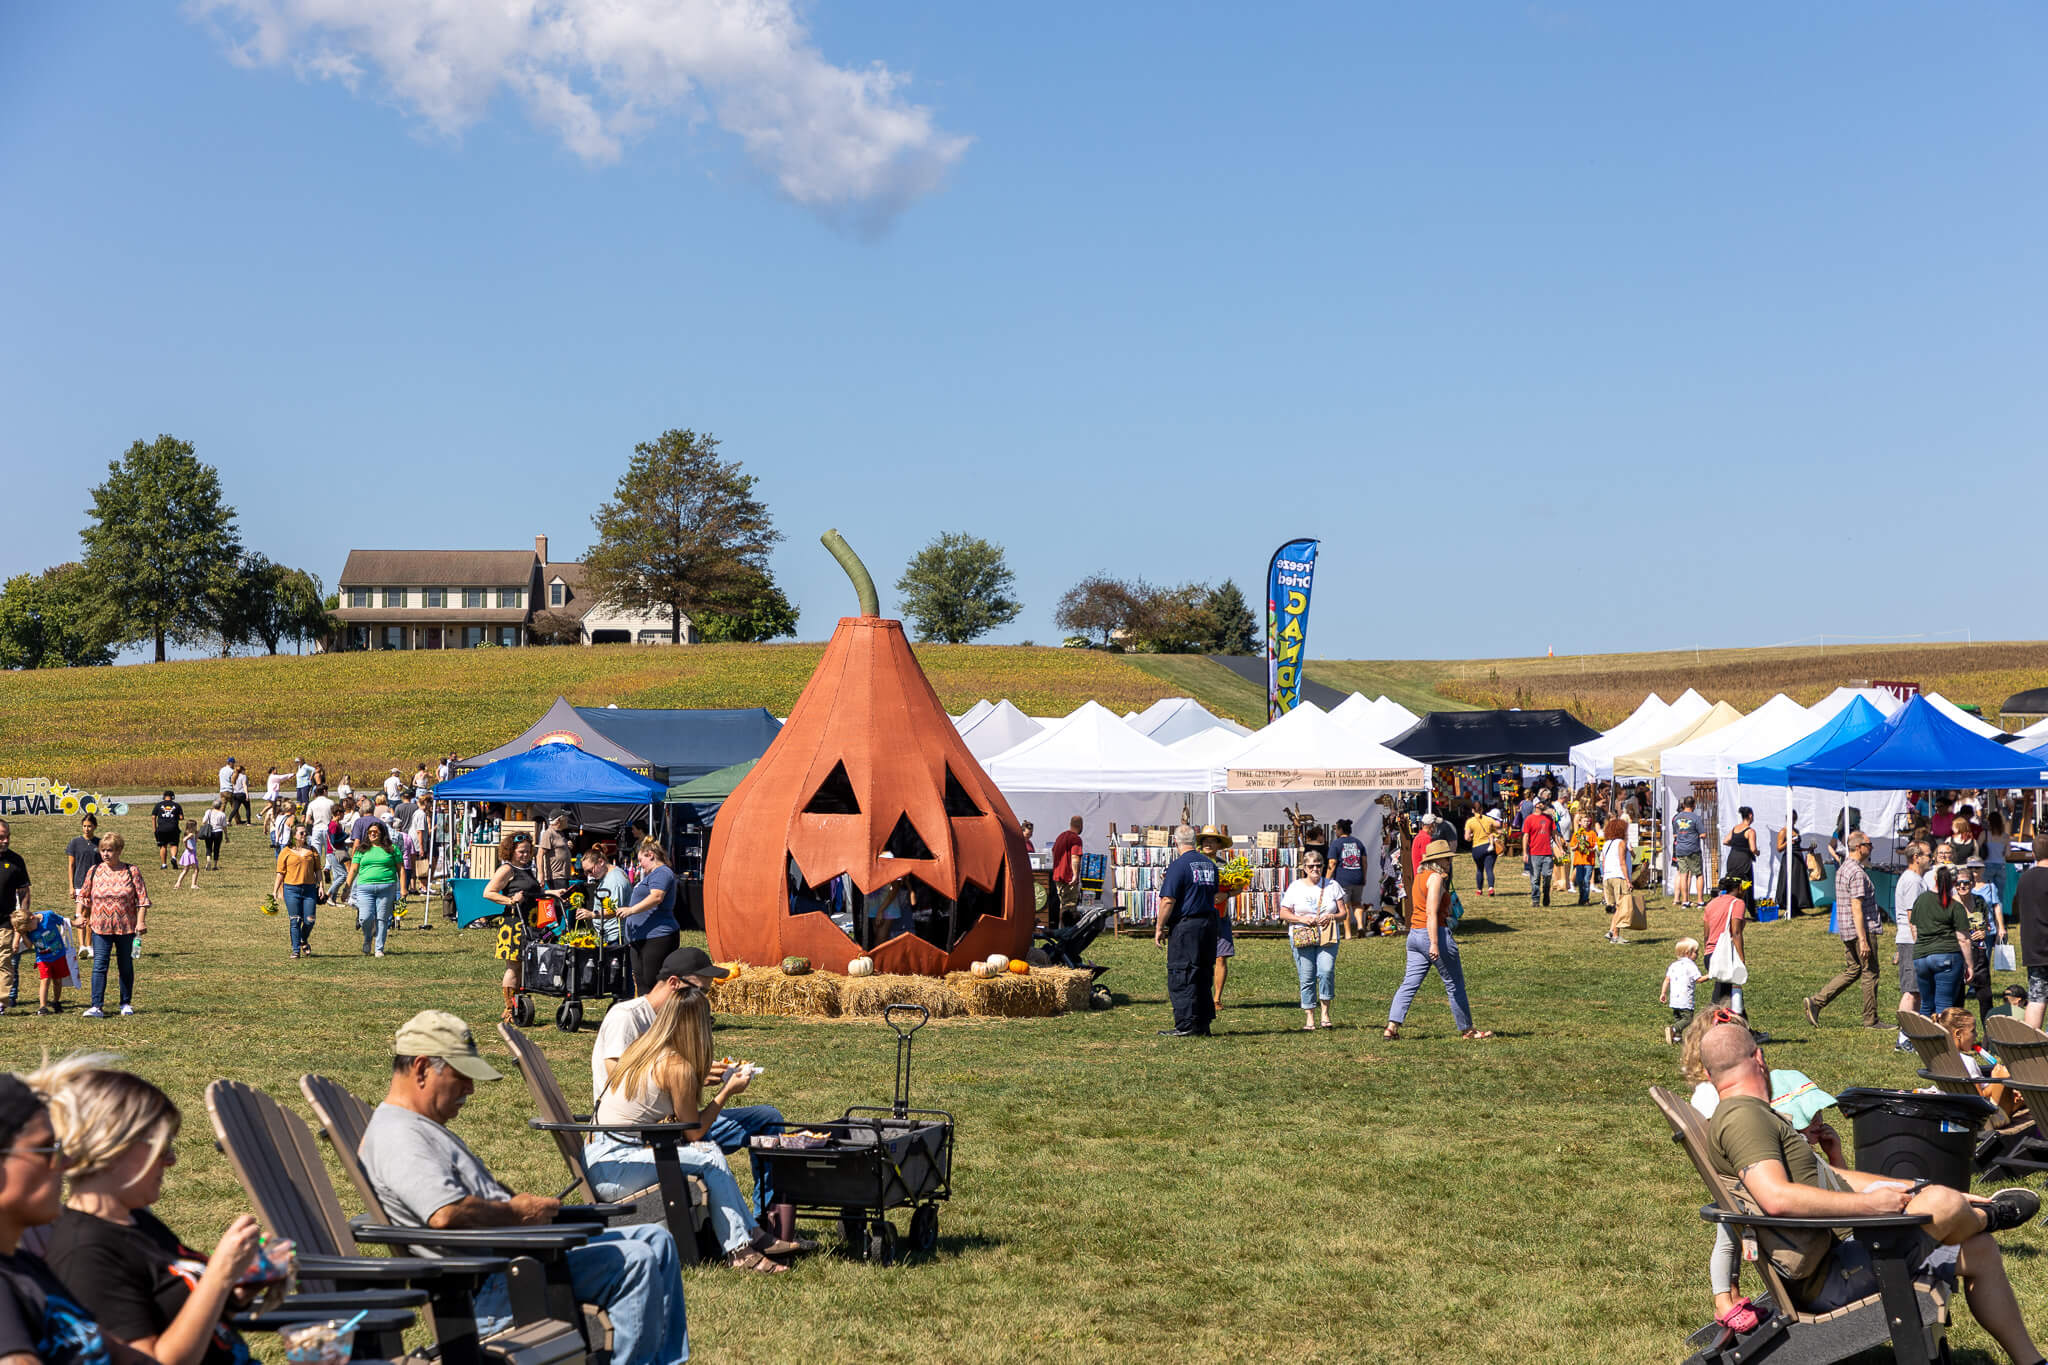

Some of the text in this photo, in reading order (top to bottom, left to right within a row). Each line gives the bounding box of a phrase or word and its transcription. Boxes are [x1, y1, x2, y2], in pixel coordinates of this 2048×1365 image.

[1325, 770, 1336, 778] PET
[1338, 769, 1363, 778] COLLARS
[1365, 769, 1377, 777] AND
[1313, 779, 1337, 787] CUSTOM
[1379, 778, 1393, 786] DONE
[1396, 778, 1405, 786] ON
